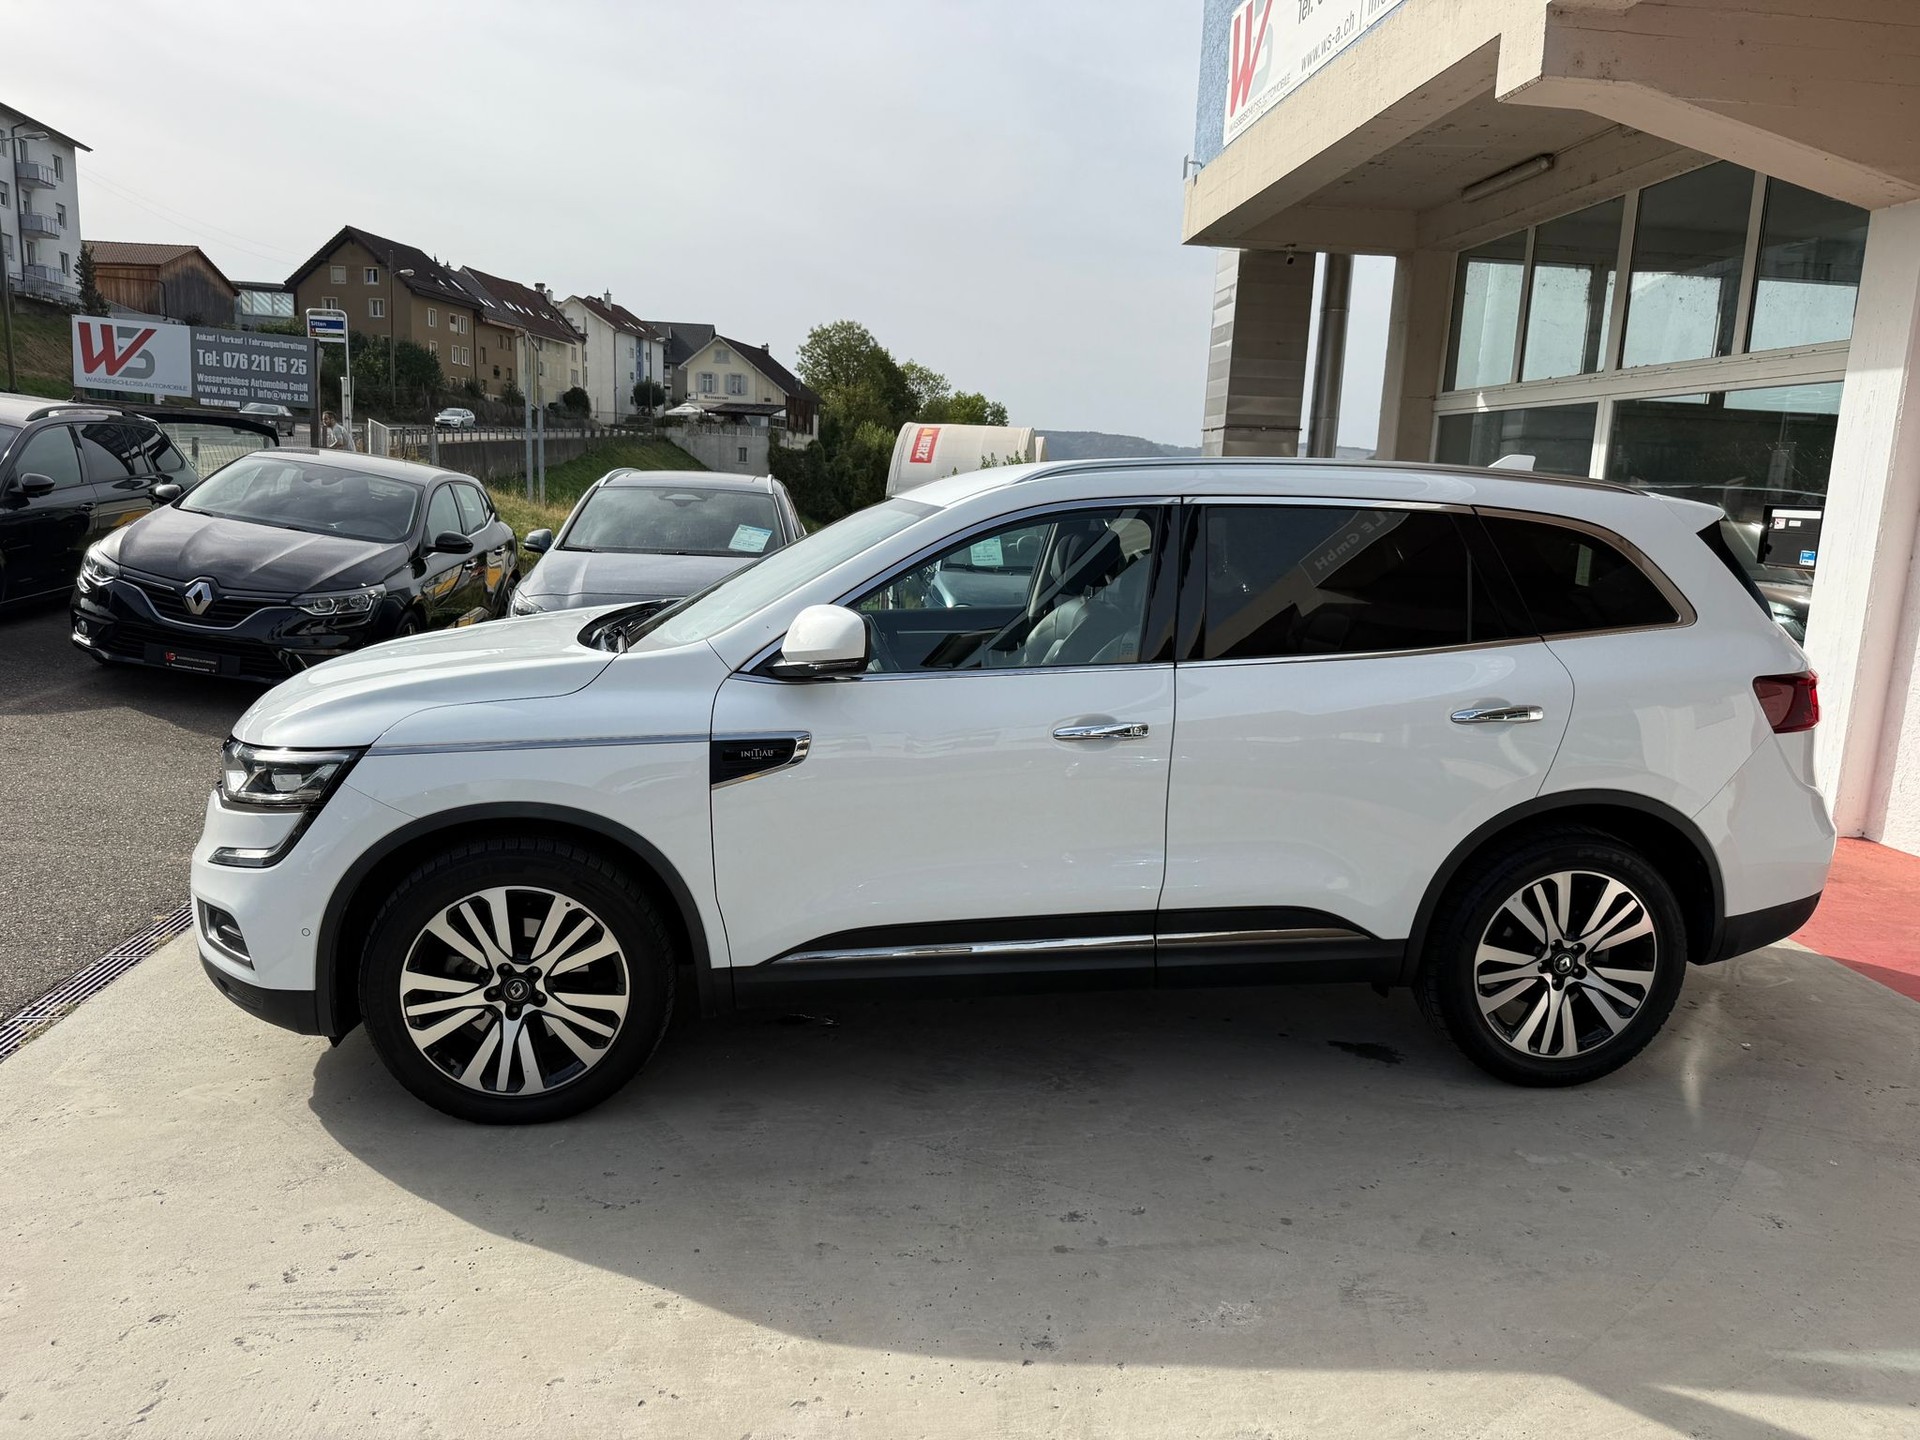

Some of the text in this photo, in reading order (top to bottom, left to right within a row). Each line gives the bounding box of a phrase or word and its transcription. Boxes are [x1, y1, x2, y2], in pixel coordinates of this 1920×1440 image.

[1301, 11, 1354, 72] www.ws-a.ch
[196, 333, 308, 352] Ankauf Verkauf Fahrzeugaufbereitung
[197, 349, 307, 375] Tel: 076 211 15 25
[85, 376, 188, 391] WASSERSCHLOSS AUTOMOBILE
[197, 373, 308, 392] Wasserschloss Automobile GmbH
[197, 384, 309, 402] www.ws-a.ch info@ws-a.ch
[915, 436, 933, 461] MERZ
